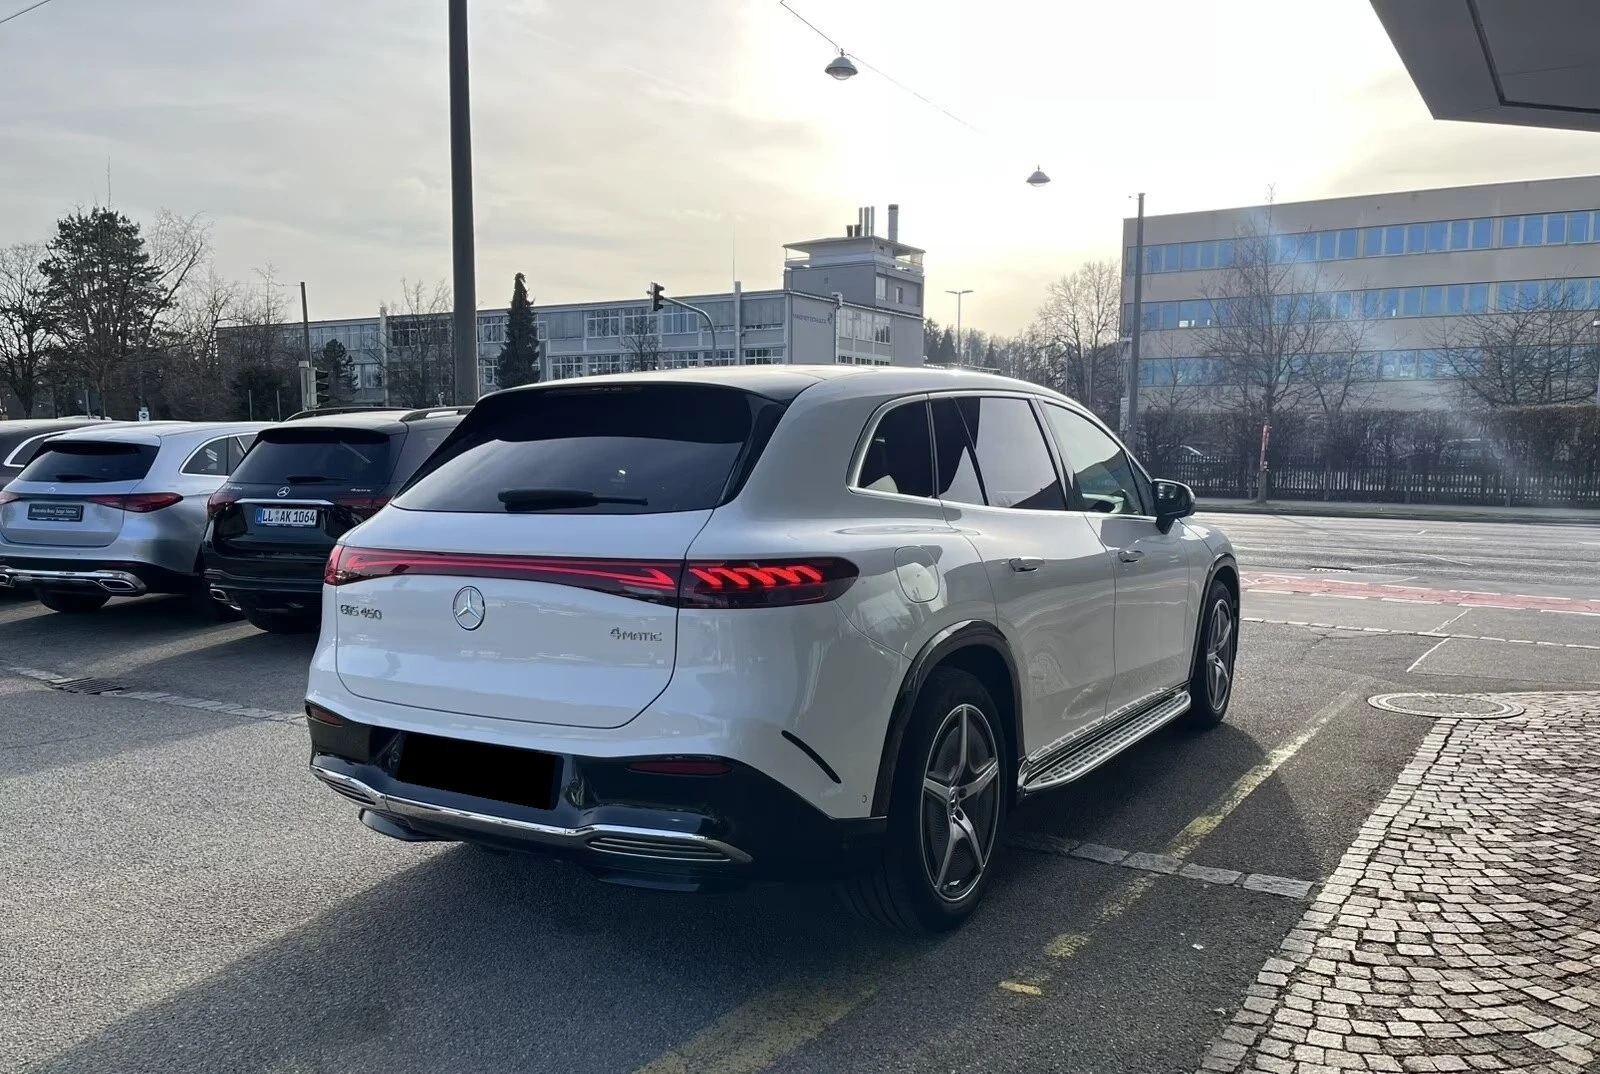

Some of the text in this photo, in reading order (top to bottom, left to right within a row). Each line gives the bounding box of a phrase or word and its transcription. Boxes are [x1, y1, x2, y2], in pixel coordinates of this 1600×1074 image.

[262, 510, 316, 523] LL AK 1064
[360, 607, 382, 620] 450
[610, 626, 662, 641] 4MATIC
